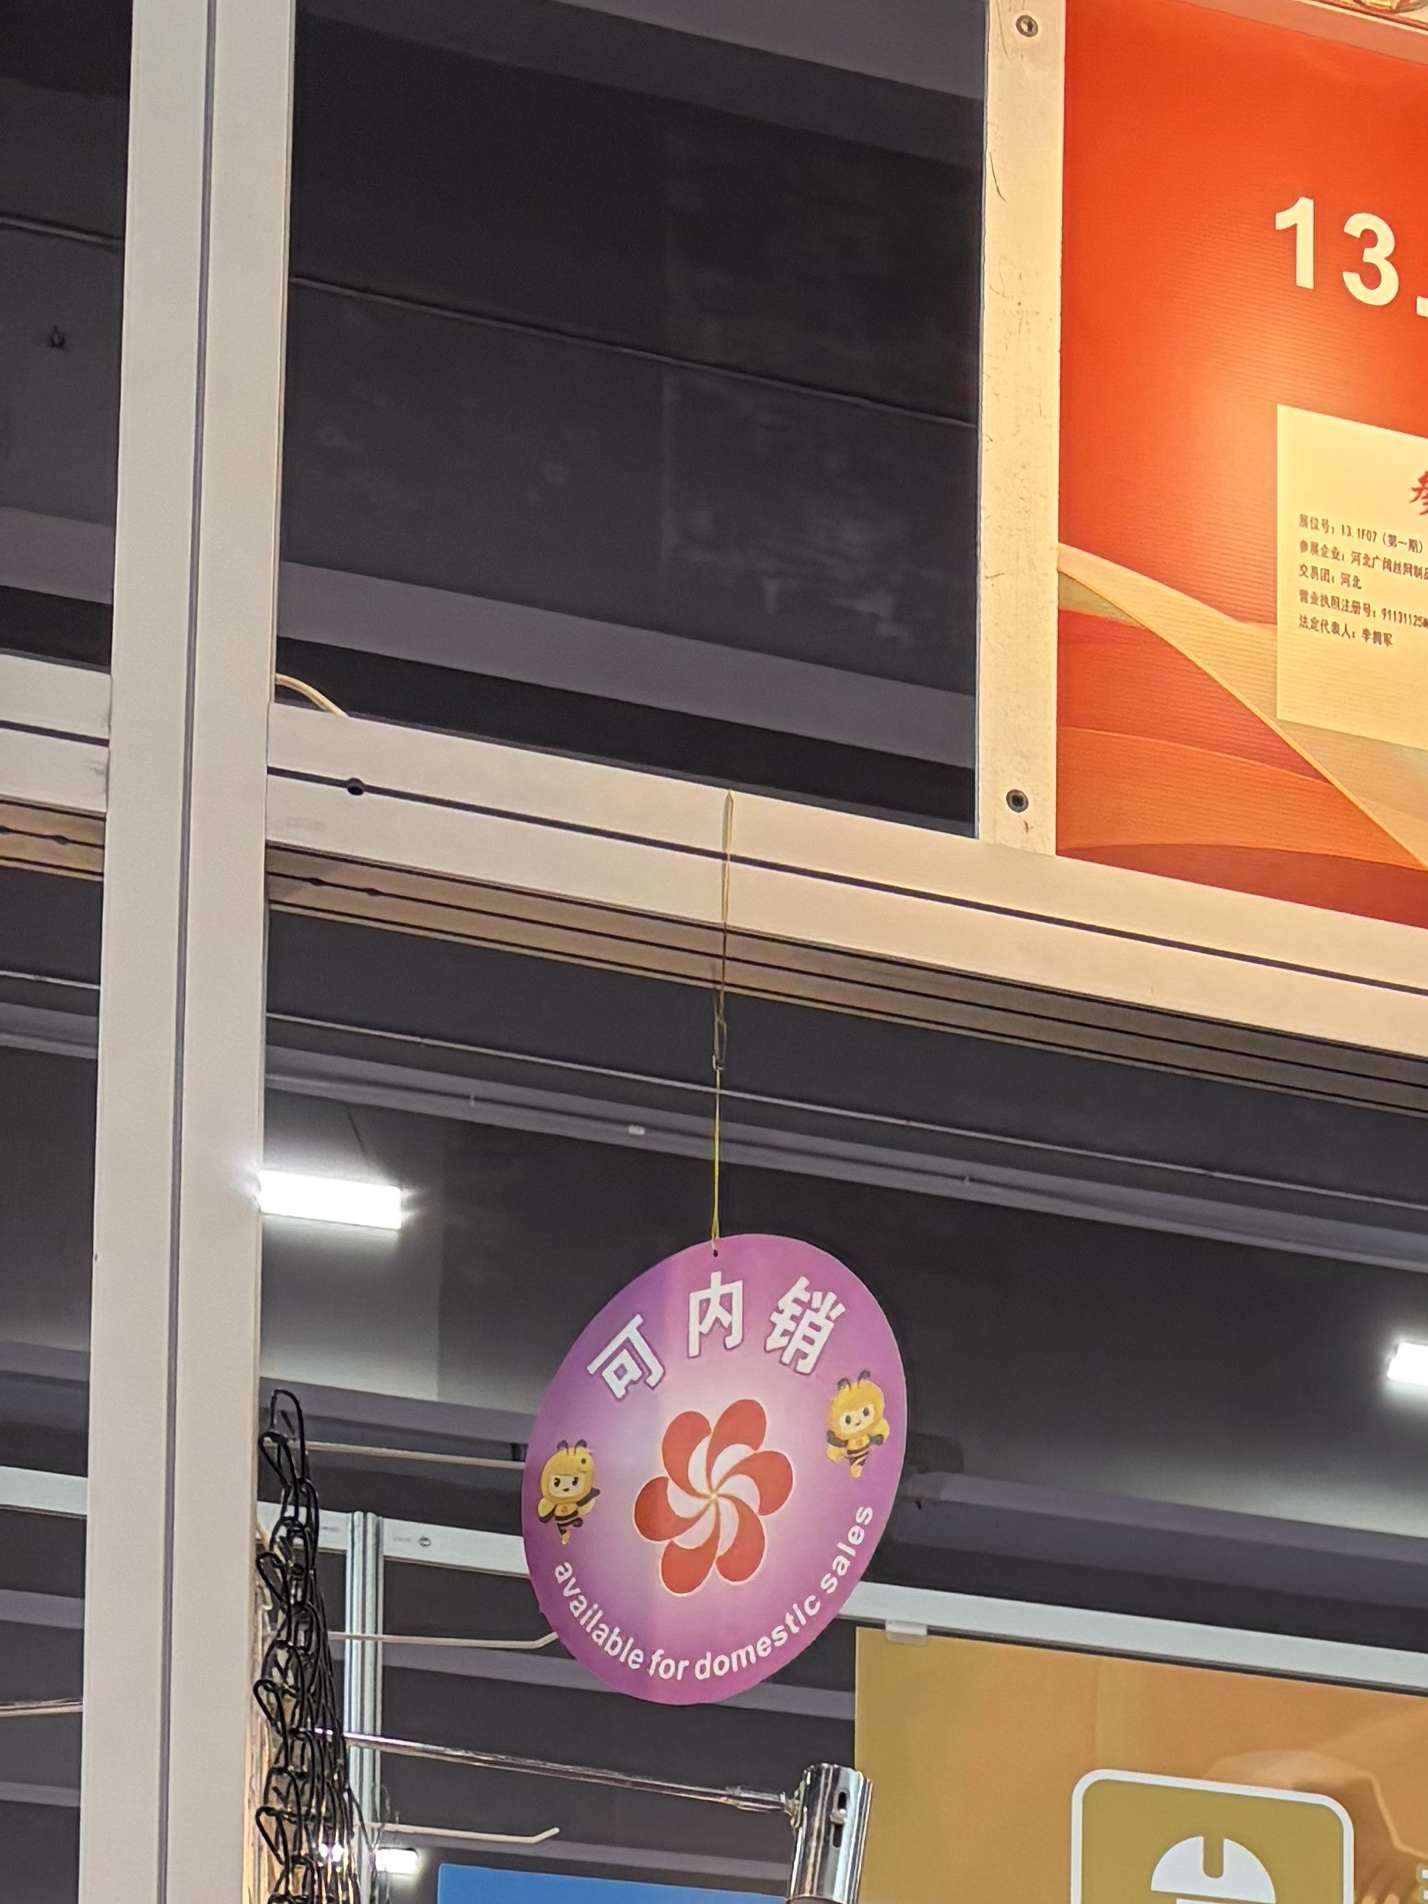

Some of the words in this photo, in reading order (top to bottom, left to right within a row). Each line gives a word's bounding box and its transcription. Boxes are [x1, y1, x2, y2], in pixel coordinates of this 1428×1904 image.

[587, 1270, 845, 1400] 可内销
[555, 1561, 644, 1671] available
[648, 1649, 690, 1681] for
[694, 1593, 821, 1682] domestic
[820, 1505, 873, 1594] sales
